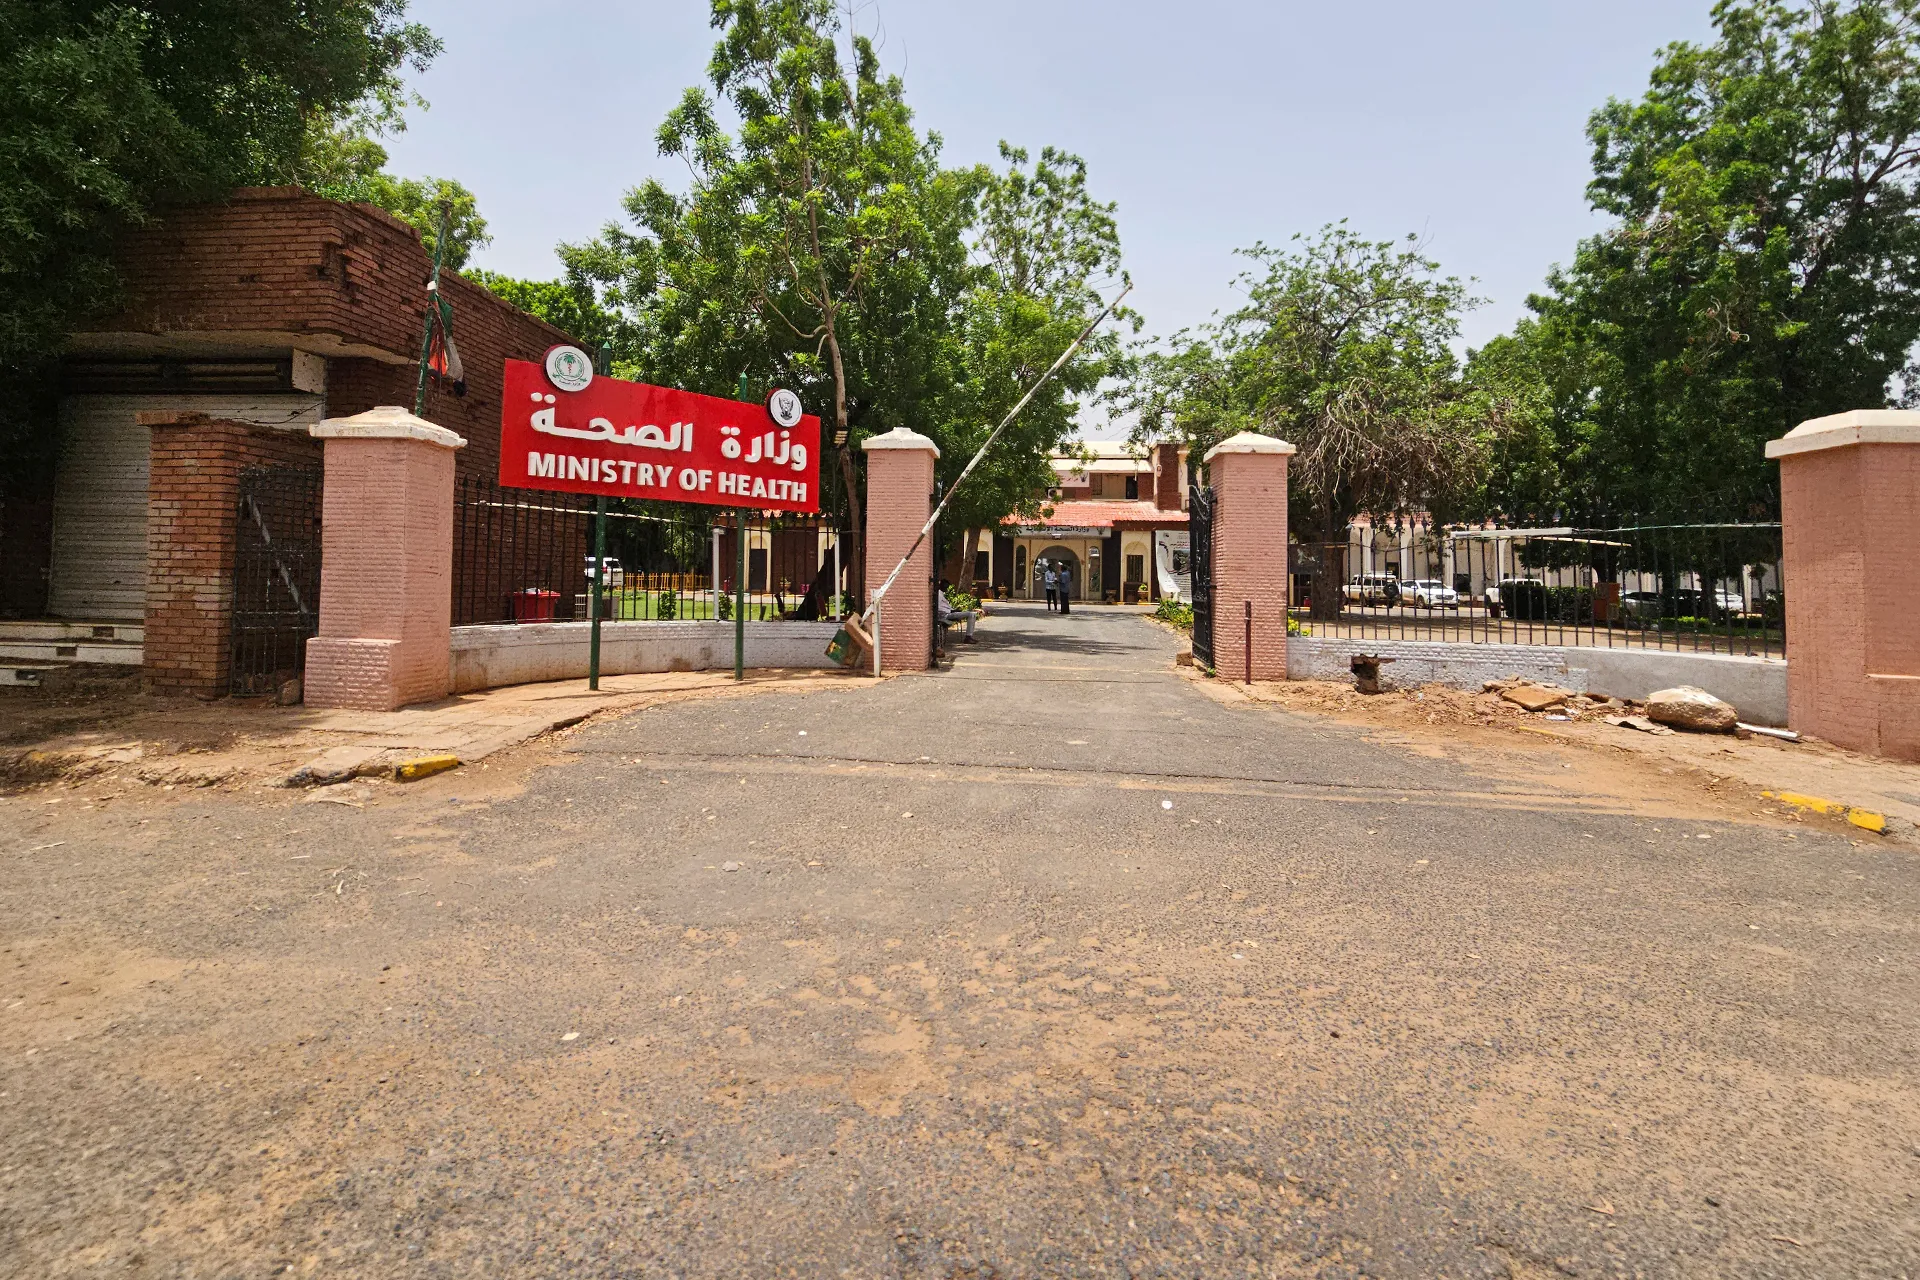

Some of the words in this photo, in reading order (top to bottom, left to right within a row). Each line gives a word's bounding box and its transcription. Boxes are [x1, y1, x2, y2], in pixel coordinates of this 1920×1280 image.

[530, 392, 693, 452] الصحة
[720, 426, 807, 471] وزارة
[527, 451, 673, 488] MINISTRY
[679, 468, 712, 491] OF
[718, 472, 807, 502] HEALTH
